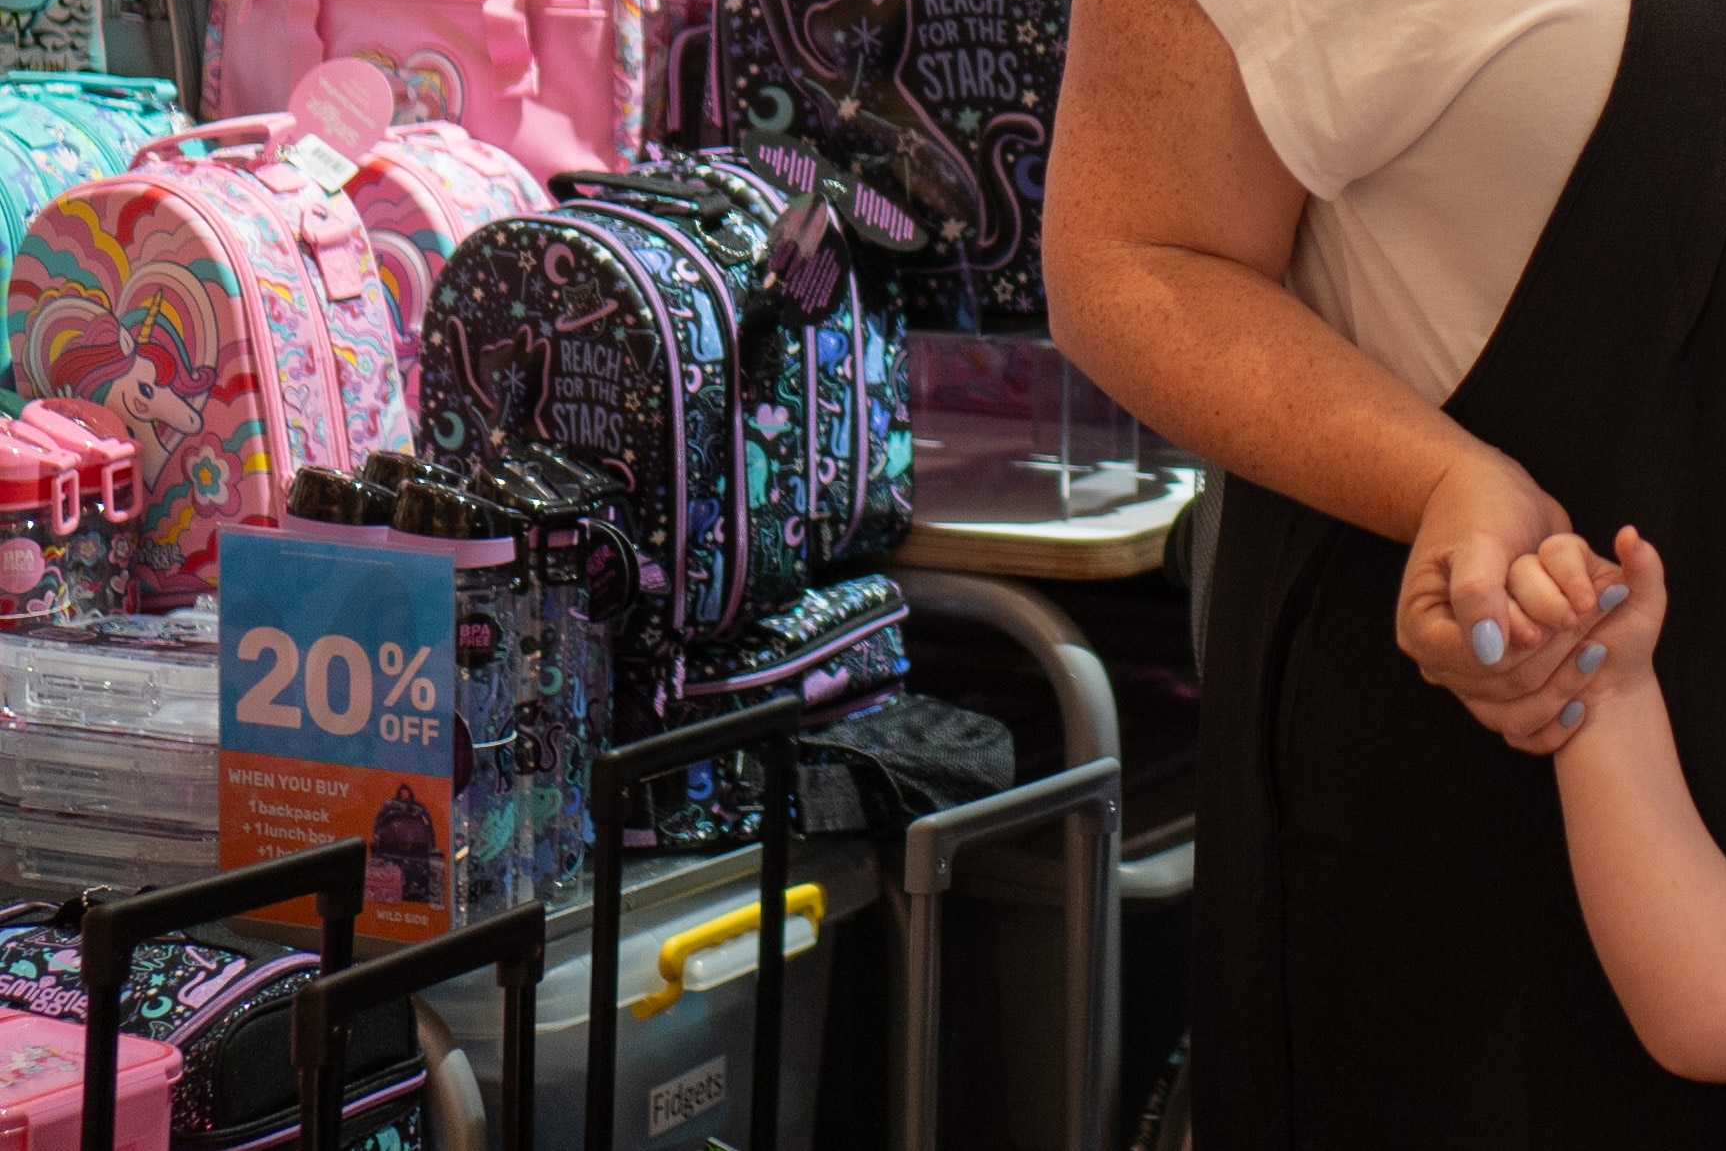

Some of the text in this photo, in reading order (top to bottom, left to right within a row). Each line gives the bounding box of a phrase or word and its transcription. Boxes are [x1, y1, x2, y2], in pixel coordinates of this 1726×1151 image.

[917, 18, 1008, 47] FOR THE
[917, 48, 1018, 101] STARS
[560, 338, 622, 382] REACH
[554, 376, 619, 407] FOR THE
[552, 401, 624, 454] STARS
[460, 623, 490, 637] BPA
[236, 626, 437, 736] 20%
[379, 713, 439, 746] OFF
[228, 768, 350, 798] WHEN YOU BUY
[259, 800, 330, 823] backpack
[264, 823, 306, 842] lunch
[653, 1073, 722, 1125] Fidgets
